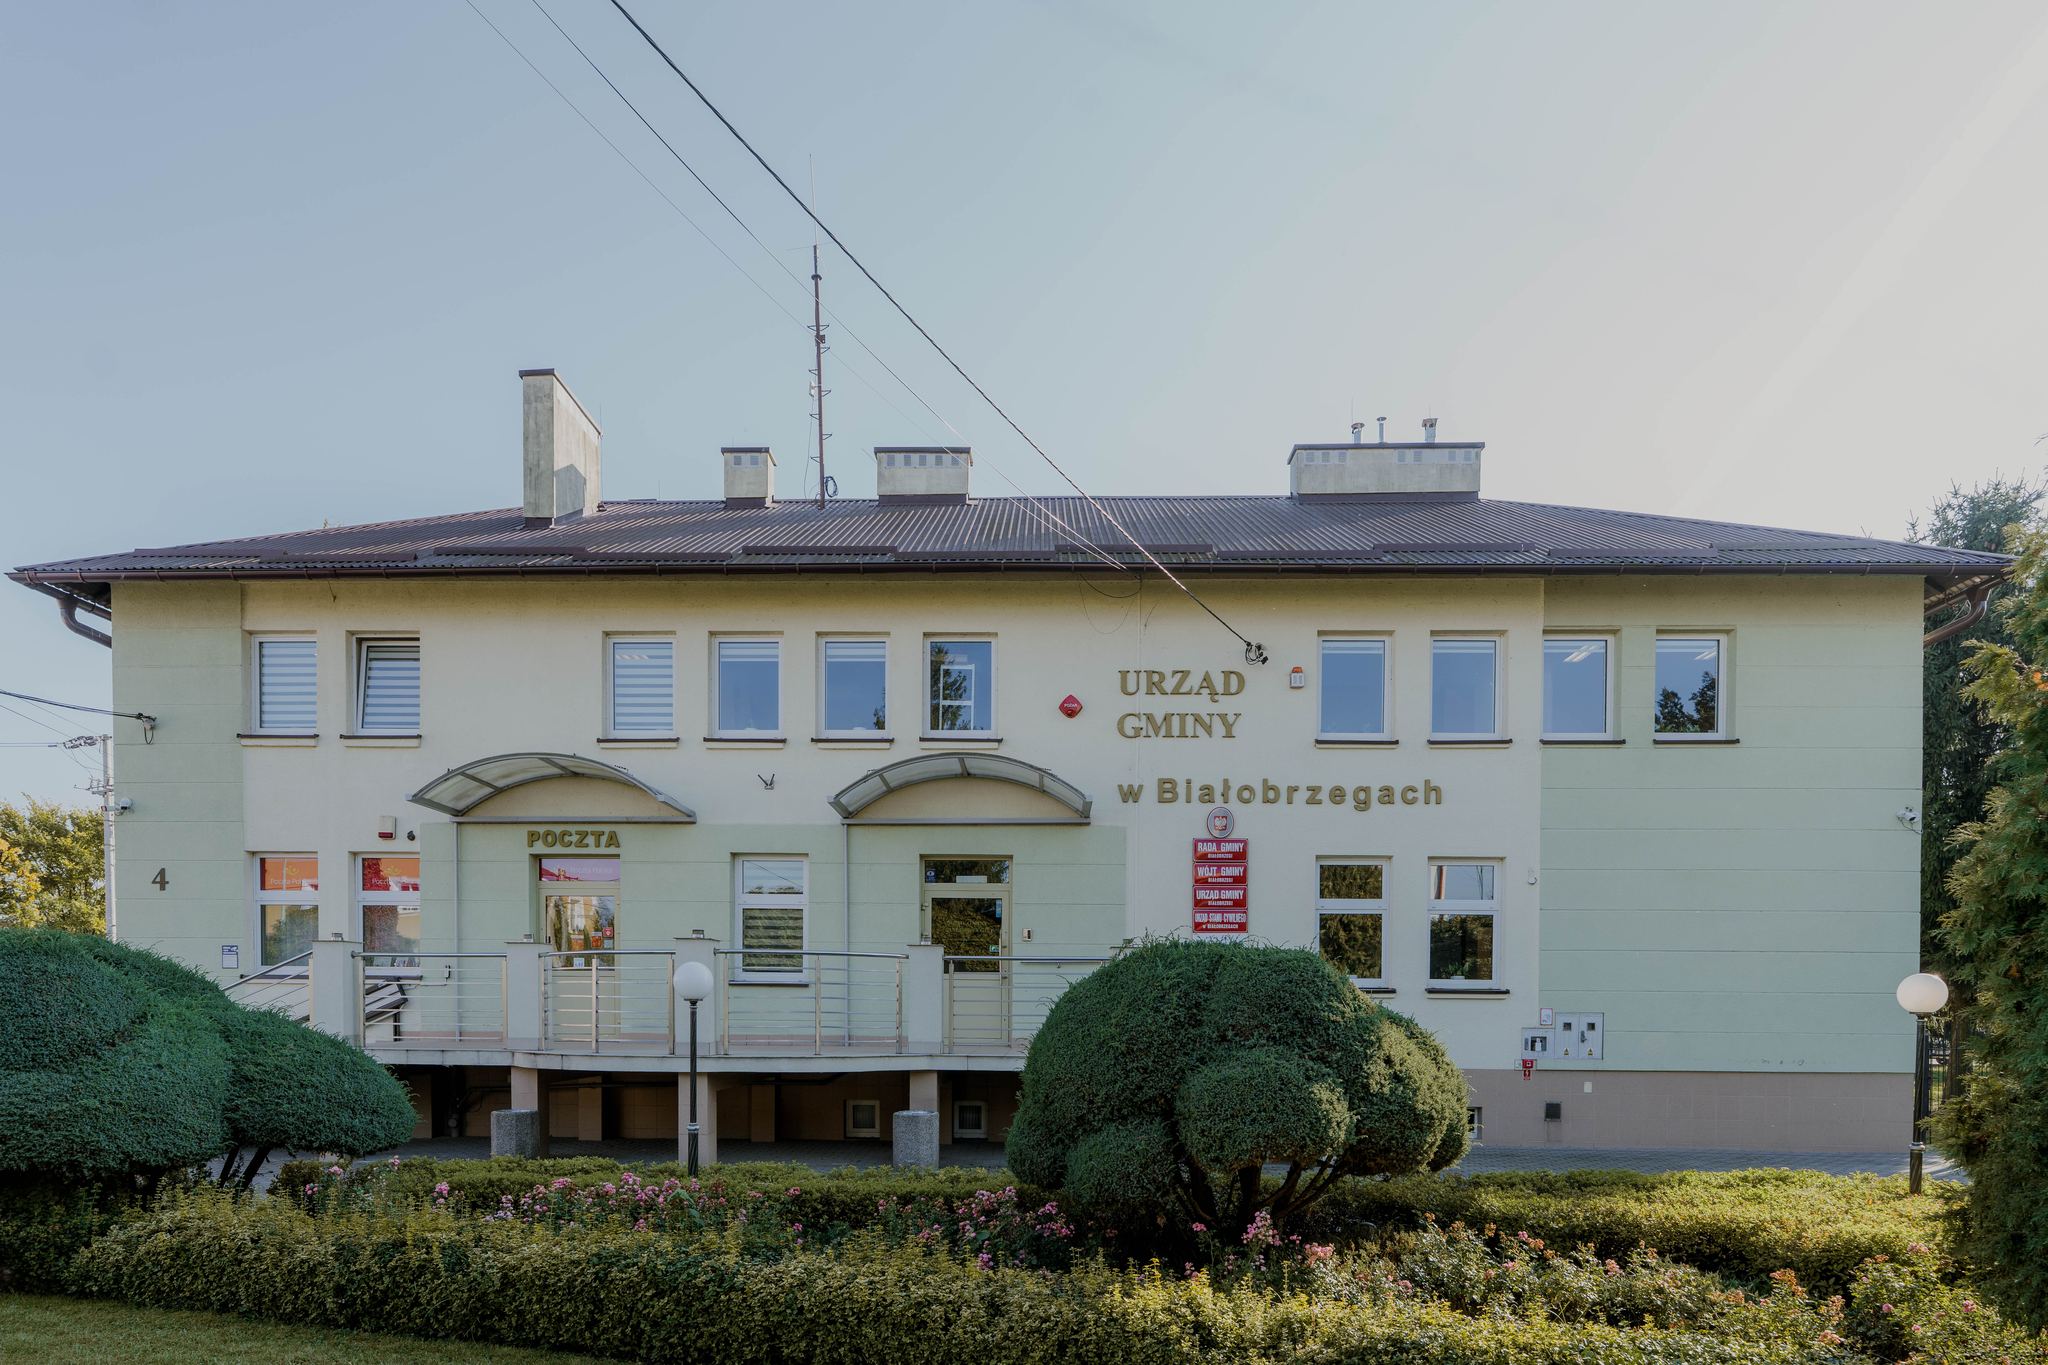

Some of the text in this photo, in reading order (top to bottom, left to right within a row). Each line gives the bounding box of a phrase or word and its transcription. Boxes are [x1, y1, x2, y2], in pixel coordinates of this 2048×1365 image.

[1118, 669, 1246, 702] URZĄD
[1116, 712, 1242, 738] GMINY
[1117, 777, 1443, 812] w Białobrzegach
[526, 829, 620, 848] POCZTA
[1198, 842, 1244, 852] RADA GMINY
[151, 867, 170, 891] 4
[1197, 865, 1244, 876] WÓJT GMINY
[1196, 890, 1244, 900] URZĄD GMINY
